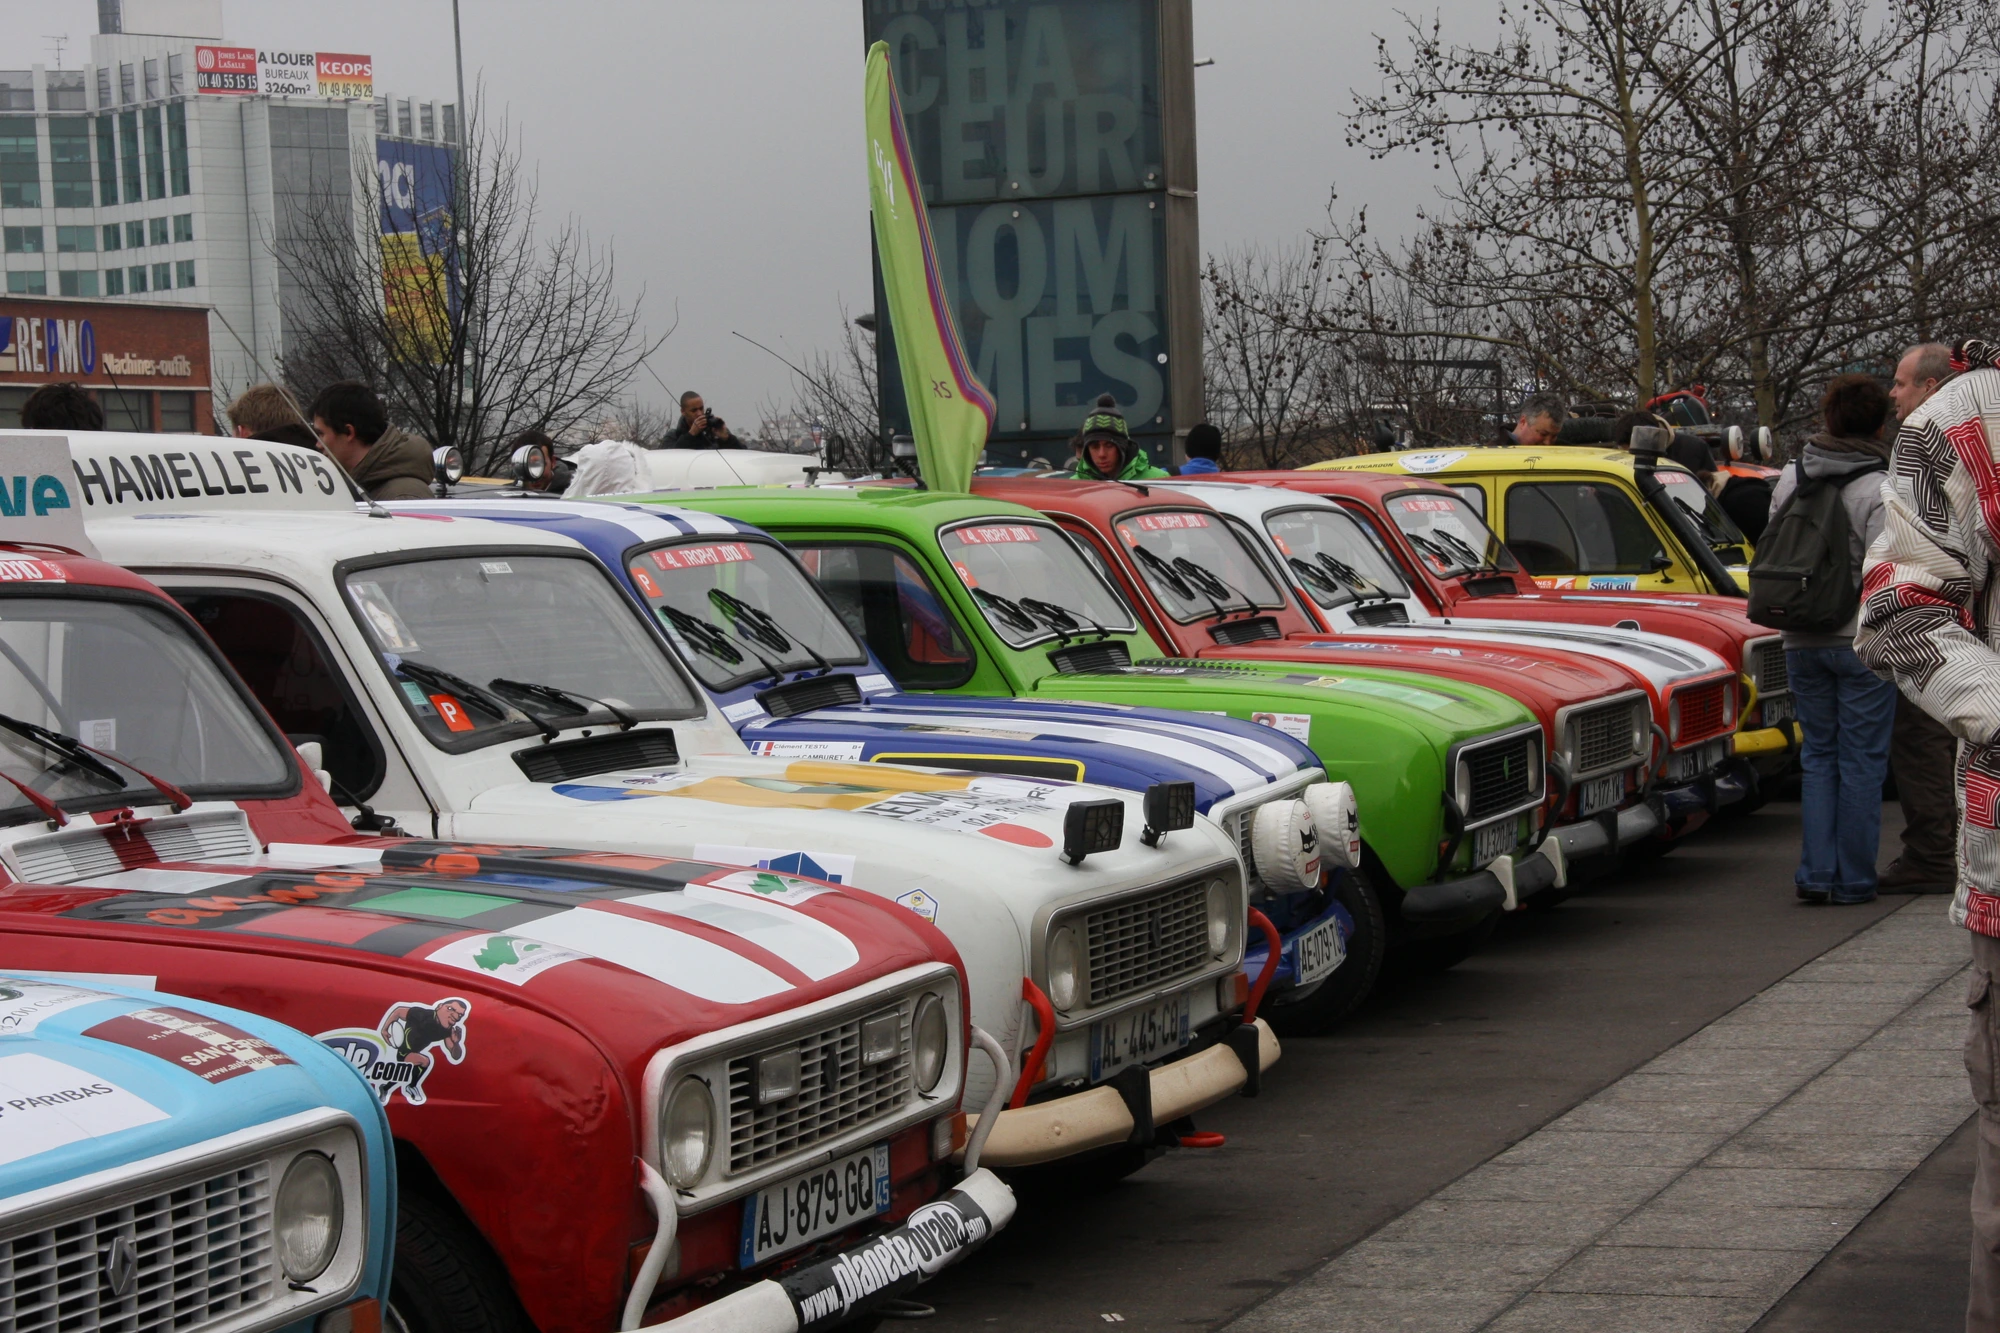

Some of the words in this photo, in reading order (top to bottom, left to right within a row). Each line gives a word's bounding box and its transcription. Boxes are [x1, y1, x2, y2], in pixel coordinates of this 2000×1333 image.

[258, 52, 268, 64] A
[272, 52, 314, 66] LOUER
[265, 68, 309, 80] BUREAUX
[320, 62, 372, 76] KEOPS
[199, 73, 208, 88] 01
[210, 73, 222, 88] 40
[224, 74, 234, 88] 55
[236, 74, 246, 89] 15
[248, 74, 257, 90] 15
[319, 82, 327, 95] 01
[330, 82, 340, 96] 49
[342, 82, 351, 96] 46
[354, 83, 362, 97] 29
[364, 83, 372, 98] 29
[16, 316, 96, 375] REPMO
[102, 352, 192, 377] Machines-outils
[1155, 516, 1184, 528] TROPHY
[978, 528, 1011, 542] TROPHY
[1009, 528, 1030, 541] 2010
[1122, 530, 1132, 542] P
[665, 552, 682, 568] 4L
[679, 548, 720, 566] TROPHY
[717, 545, 743, 562] 2010
[637, 573, 651, 591] P
[958, 567, 968, 582] P
[1590, 582, 1612, 590] Sidi
[1616, 582, 1632, 590] ali
[441, 702, 458, 723] P
[366, 1061, 413, 1082] .com
[8, 1083, 114, 1111] PARIBAS
[876, 1178, 890, 1207] 45
[758, 1155, 874, 1252] AJ-879-GQ
[800, 1207, 987, 1325] www.planeteovale.com
